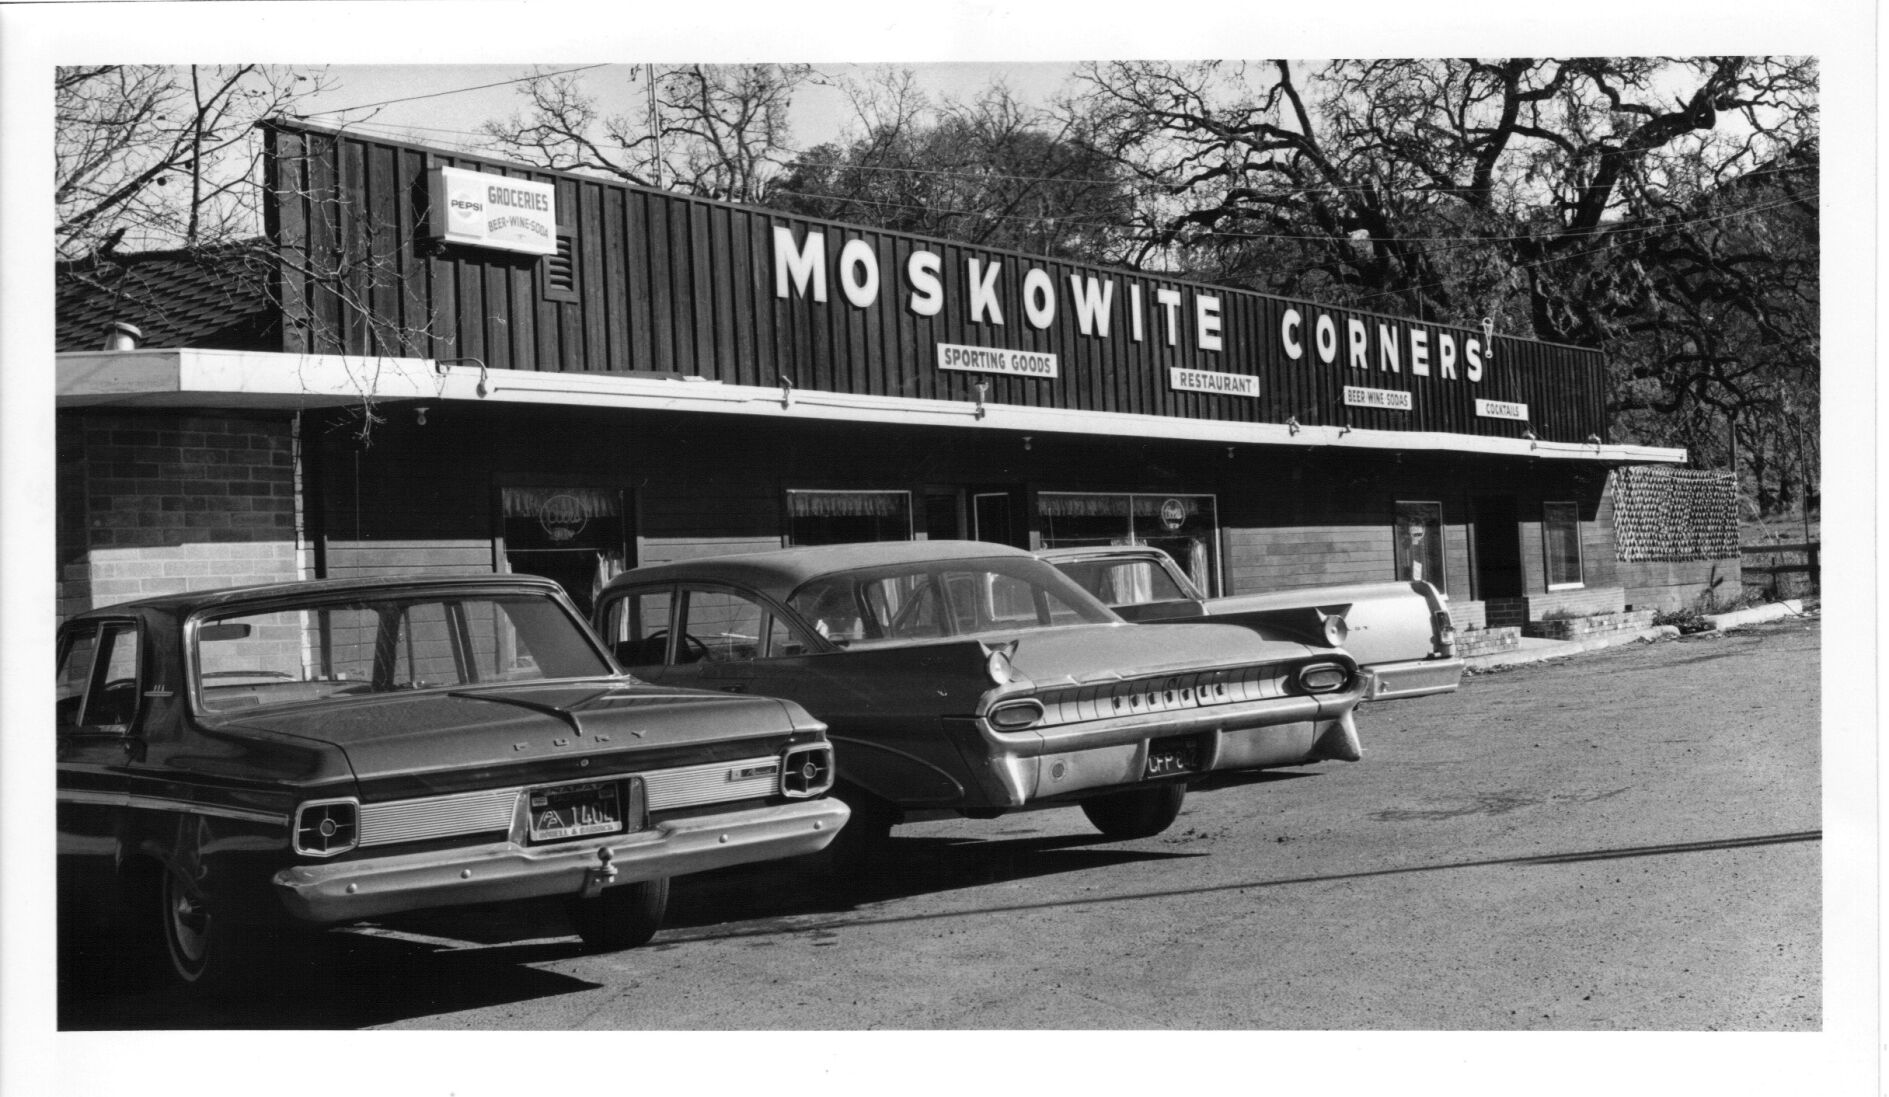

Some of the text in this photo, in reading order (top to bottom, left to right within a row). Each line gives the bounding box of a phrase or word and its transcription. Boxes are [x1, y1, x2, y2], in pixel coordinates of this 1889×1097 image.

[451, 199, 482, 212] PEPSI
[488, 186, 548, 211] GROCERIES
[773, 226, 1483, 382] MOSKOWITE CORNERS
[944, 347, 1050, 374] SPORTING GOODS
[1179, 372, 1252, 393] RESTAURANT
[1348, 389, 1408, 407] BEER WINE SODAS
[1486, 402, 1519, 417] COCKTAILS
[513, 730, 646, 751] FURY
